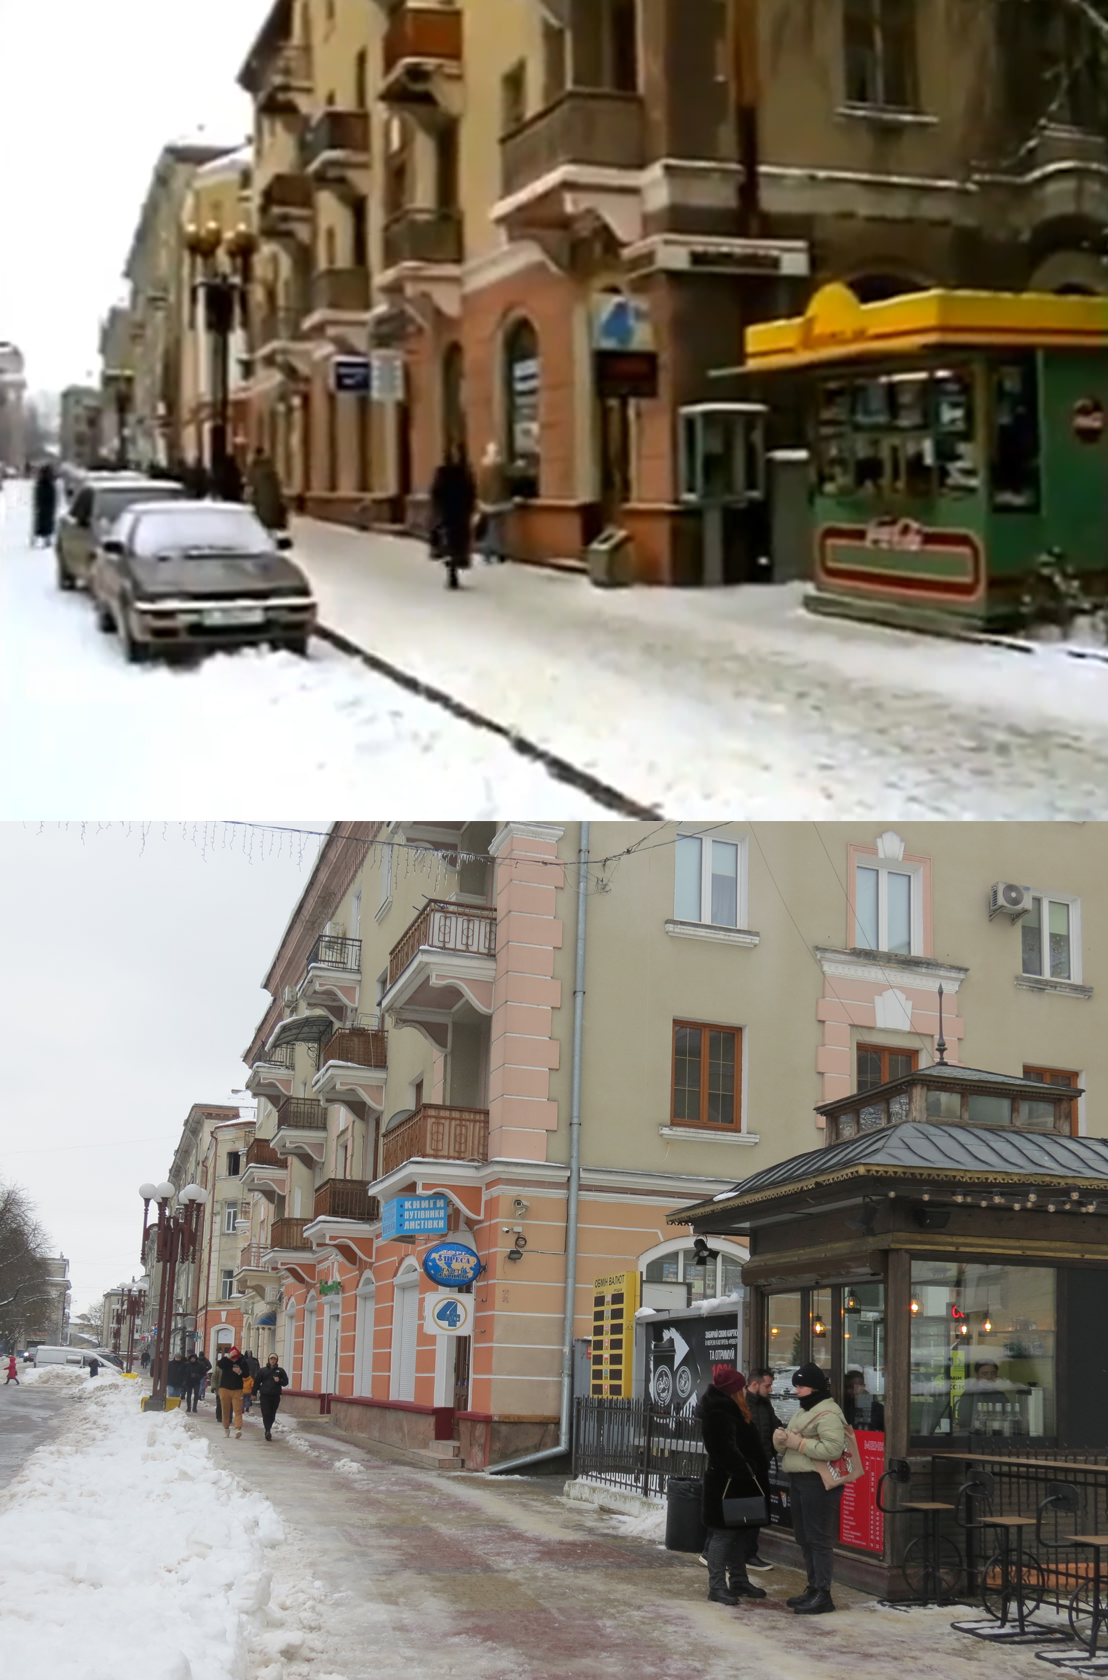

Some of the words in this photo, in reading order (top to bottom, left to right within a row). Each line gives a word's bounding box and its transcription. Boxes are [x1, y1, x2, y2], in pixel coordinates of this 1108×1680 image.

[405, 1199, 444, 1209] КНИГИ
[404, 1209, 444, 1219] ПУТІВНИКИ
[404, 1220, 444, 1230] ЛИСТІВКИ
[595, 1278, 608, 1288] ОБМІН
[608, 1274, 625, 1286] ВАЛЮТ
[436, 1301, 460, 1327] 4
[709, 1350, 715, 1360] ТА
